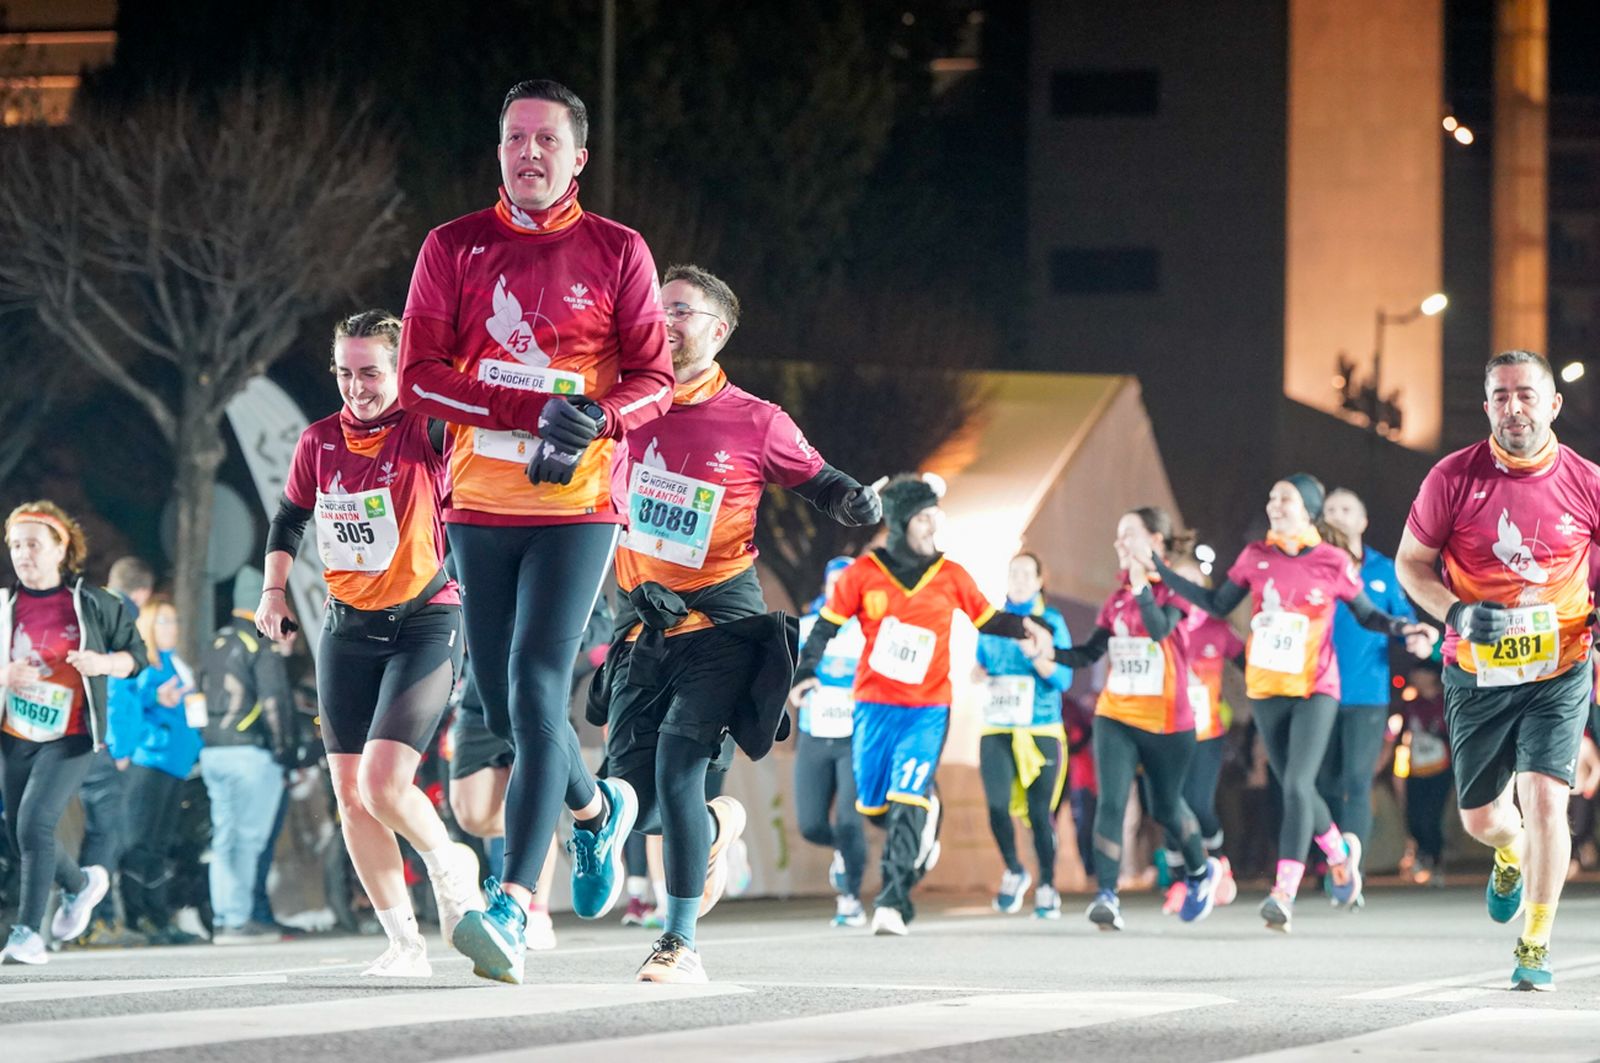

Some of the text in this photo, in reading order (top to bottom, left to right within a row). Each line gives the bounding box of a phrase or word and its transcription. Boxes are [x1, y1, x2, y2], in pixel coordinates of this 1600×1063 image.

[507, 329, 532, 353] 43
[500, 373, 531, 386] NOCHE
[532, 378, 545, 389] DE
[637, 485, 655, 497] SAN
[655, 490, 687, 505] ANTÓN
[650, 478, 676, 492] NOCHE
[676, 485, 688, 496] DE
[321, 511, 334, 520] SAN
[335, 511, 360, 521] ANTÓN
[324, 502, 358, 511] NOCHE DE
[638, 497, 699, 536] 8089
[333, 521, 375, 545] 305
[1510, 552, 1531, 572] 43
[1489, 634, 1542, 660] 2381
[13, 696, 60, 726] 13697
[900, 757, 931, 792] 11
